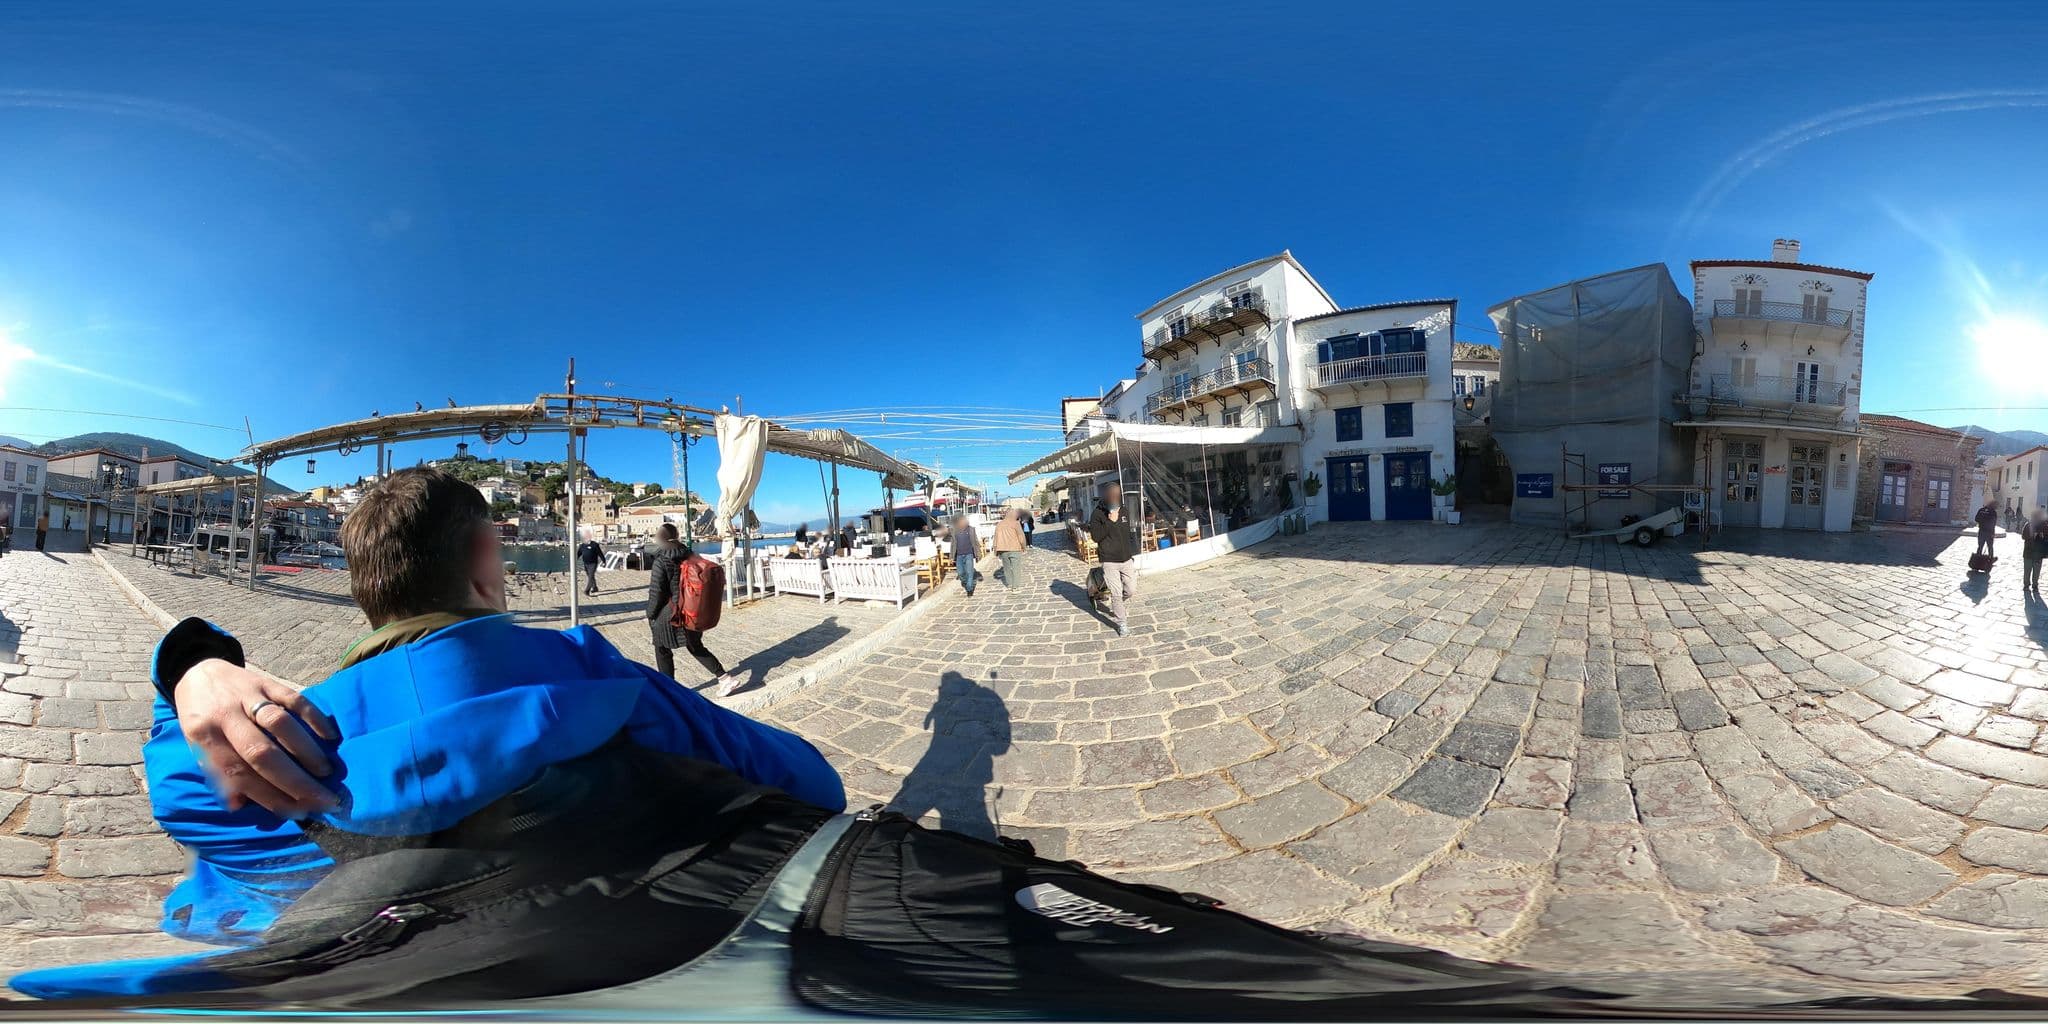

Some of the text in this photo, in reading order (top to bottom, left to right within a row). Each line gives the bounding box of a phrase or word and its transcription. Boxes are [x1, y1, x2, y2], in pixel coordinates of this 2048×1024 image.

[1600, 466, 1630, 474] FOR SALE
[1051, 901, 1174, 934] NORTH
